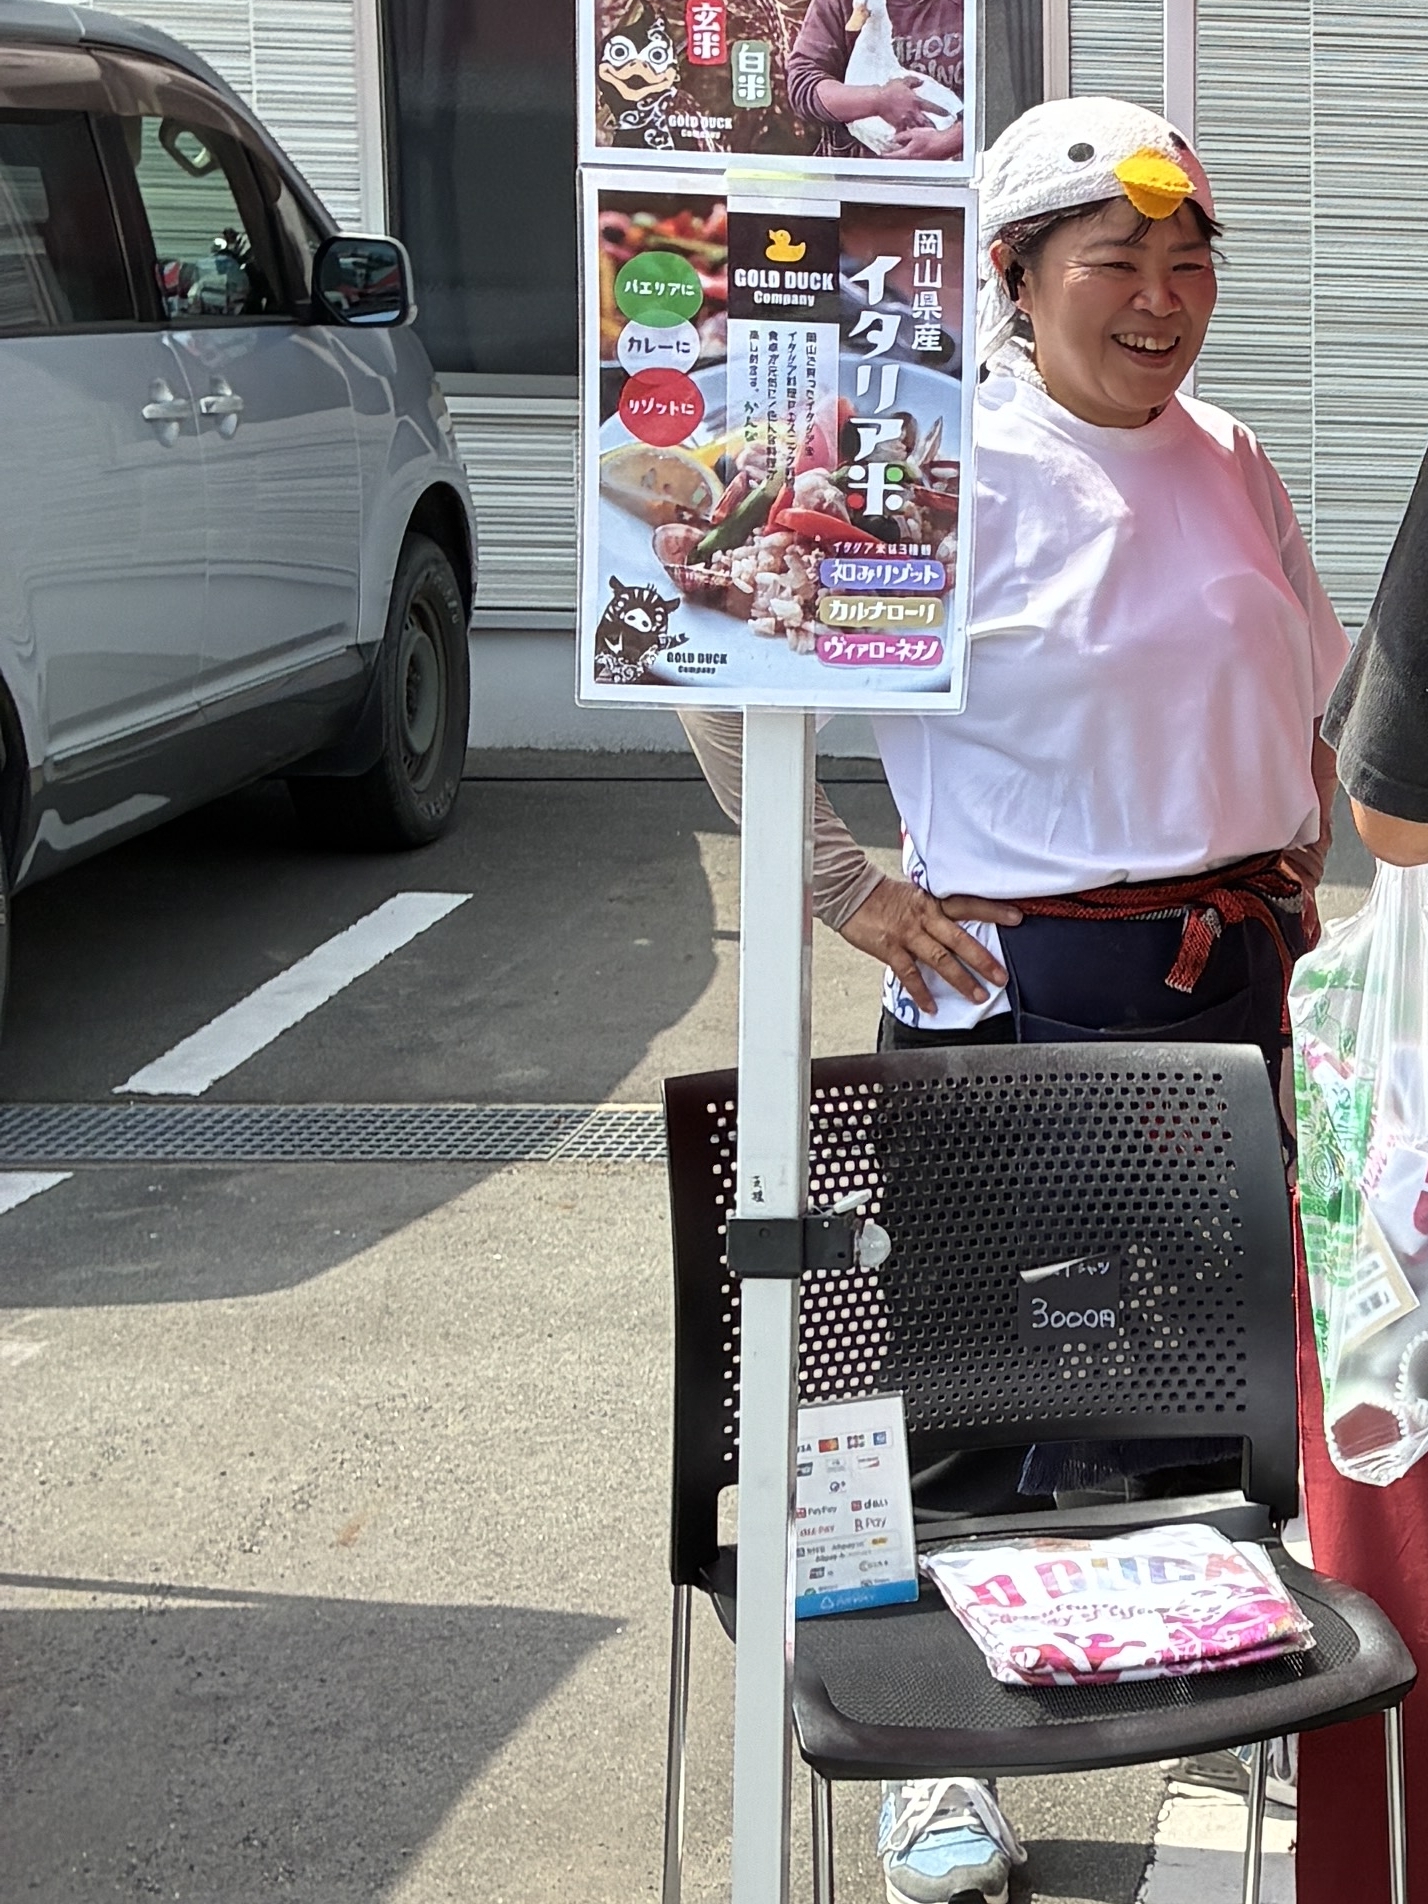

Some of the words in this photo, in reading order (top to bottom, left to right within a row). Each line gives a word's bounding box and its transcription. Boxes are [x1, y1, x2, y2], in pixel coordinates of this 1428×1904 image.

[690, 3, 723, 59] 玄米
[737, 44, 766, 102] 白米
[668, 114, 700, 129] GOLD
[701, 116, 733, 130] DUCK
[623, 278, 695, 297] パエリアに
[734, 268, 782, 289] GOLD
[784, 270, 834, 291] DUCK
[911, 228, 943, 352] 岡山県産
[753, 289, 816, 308] Company
[626, 336, 691, 355] カレーに
[846, 255, 904, 517] イタリア米
[628, 397, 695, 417] リゾットに
[830, 559, 940, 585] 和みリゾット
[828, 600, 936, 625] カルナローリ
[666, 651, 696, 665] GOLD
[697, 652, 728, 666] DUCK
